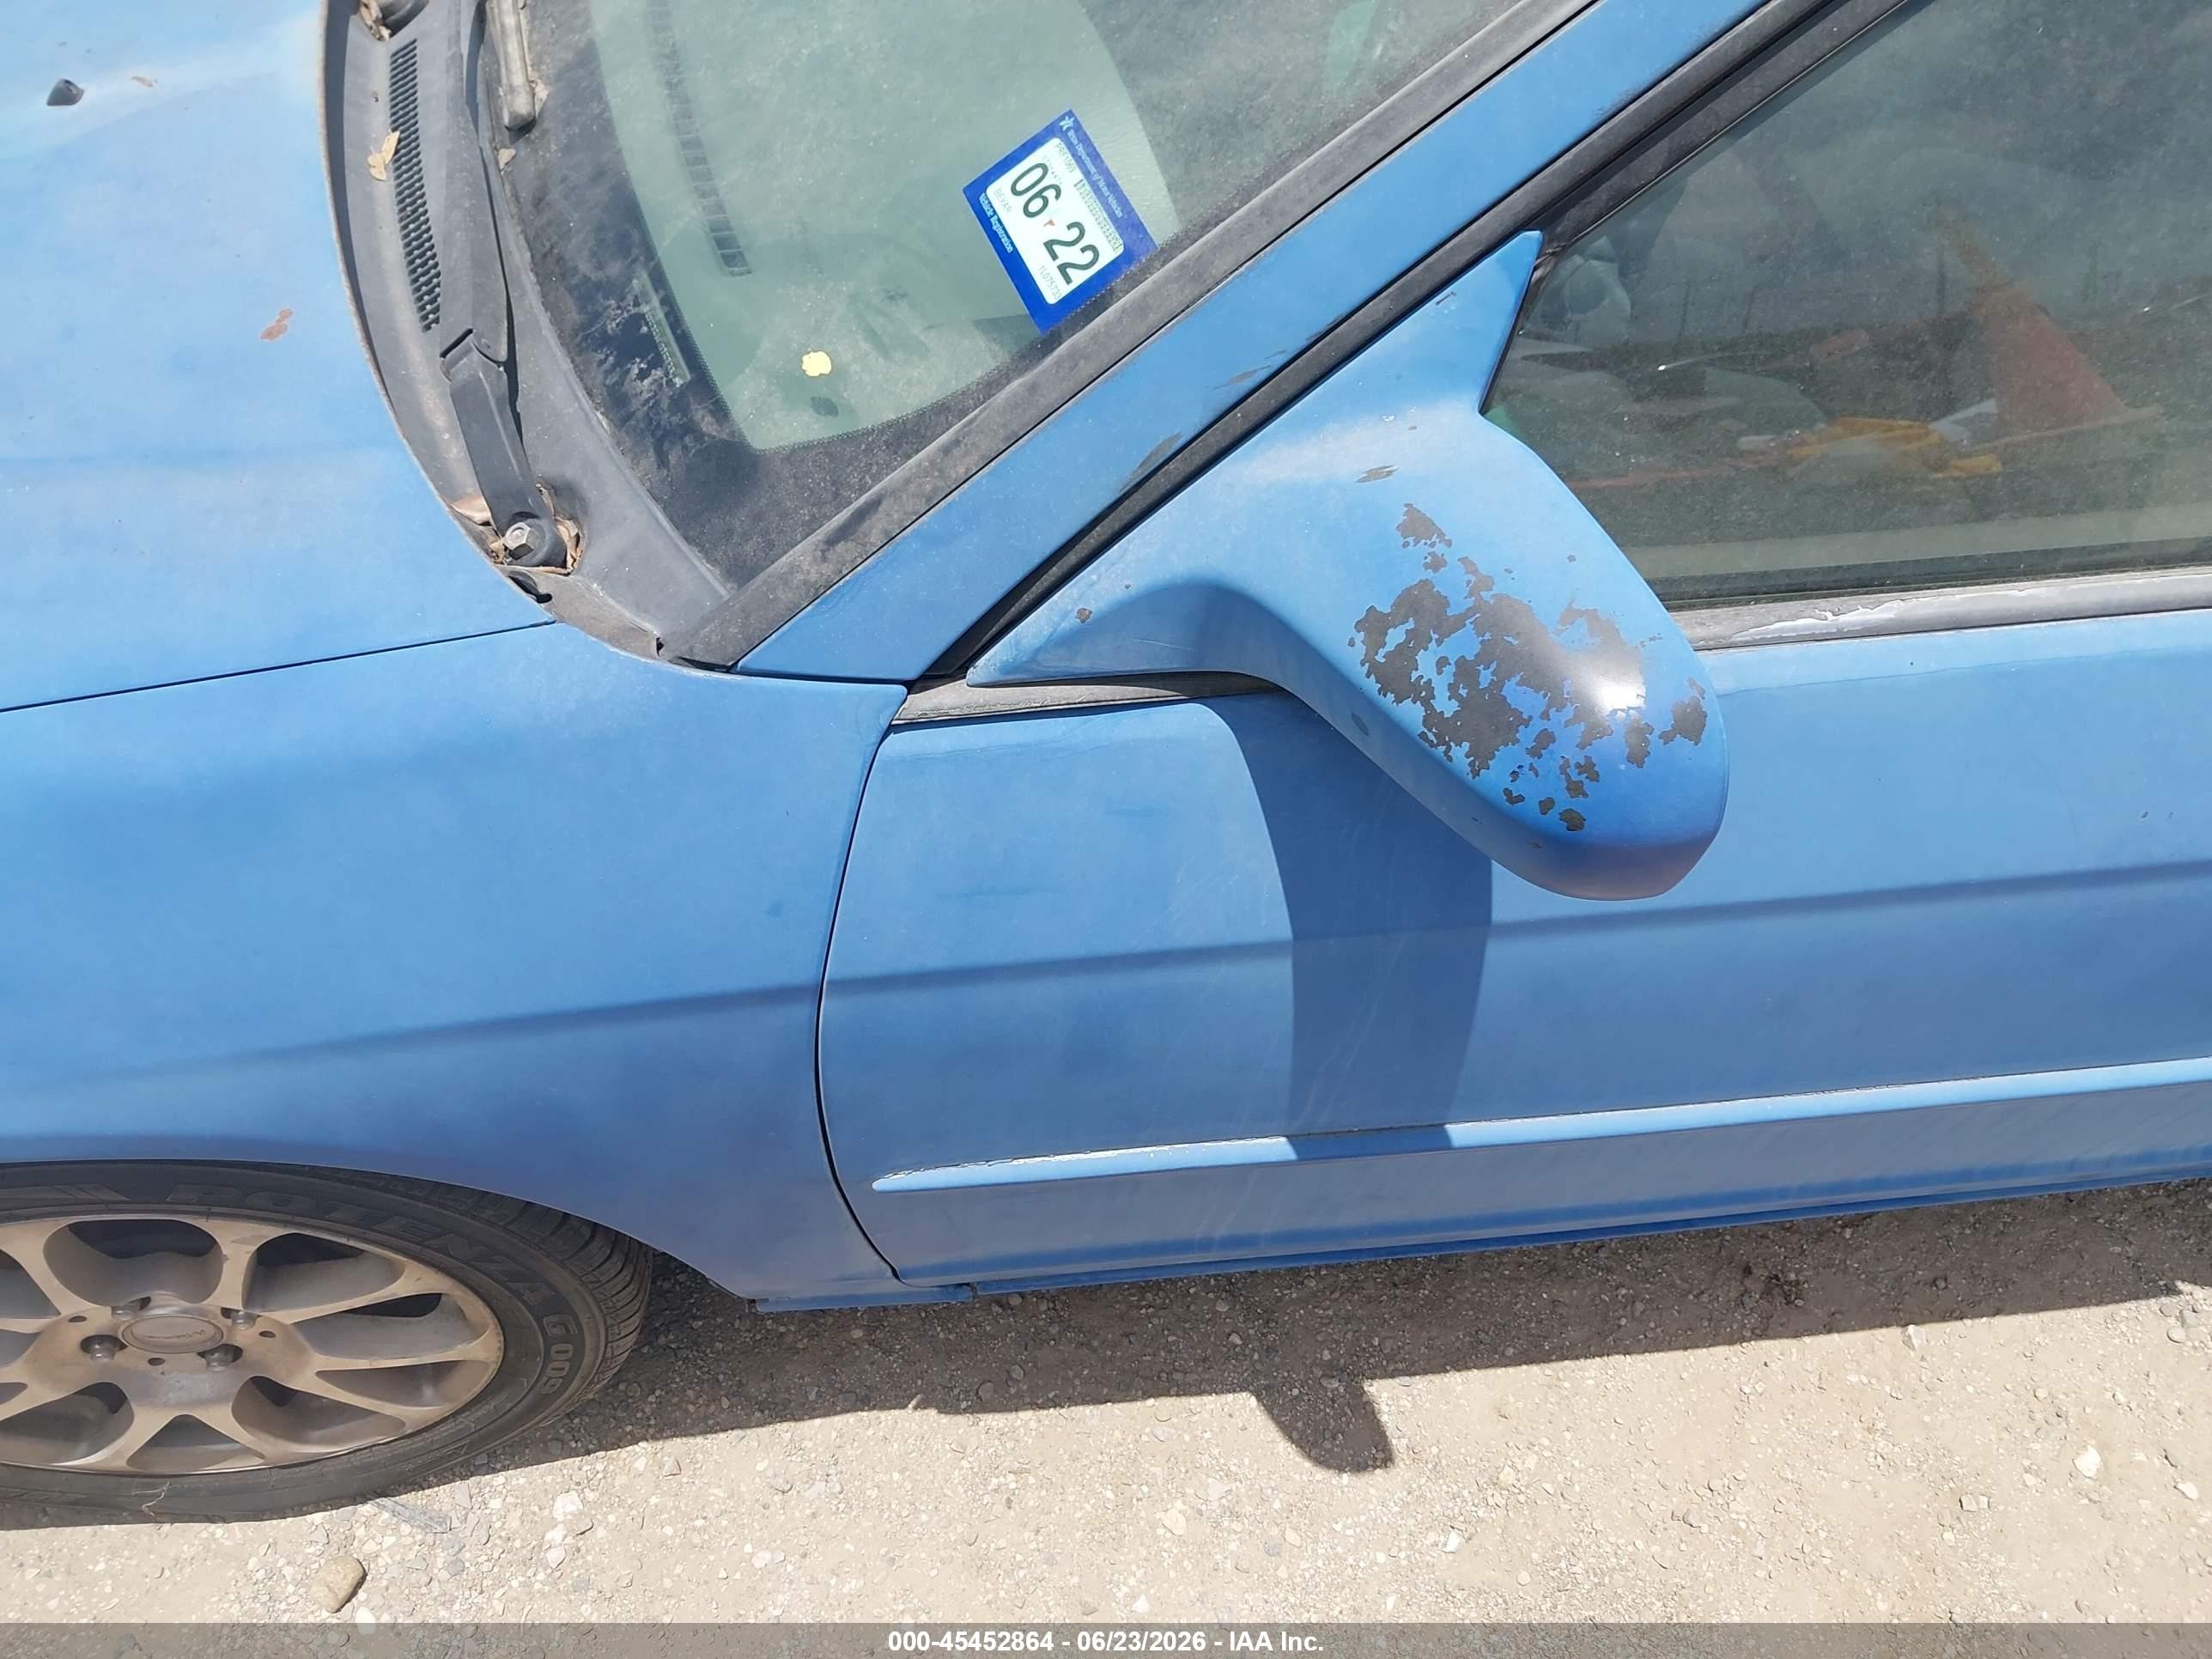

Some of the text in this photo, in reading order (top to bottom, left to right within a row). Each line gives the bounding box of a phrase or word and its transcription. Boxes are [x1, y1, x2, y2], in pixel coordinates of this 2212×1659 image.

[977, 192, 1014, 254] Vehicle Registration
[1011, 162, 1100, 285] 06 22
